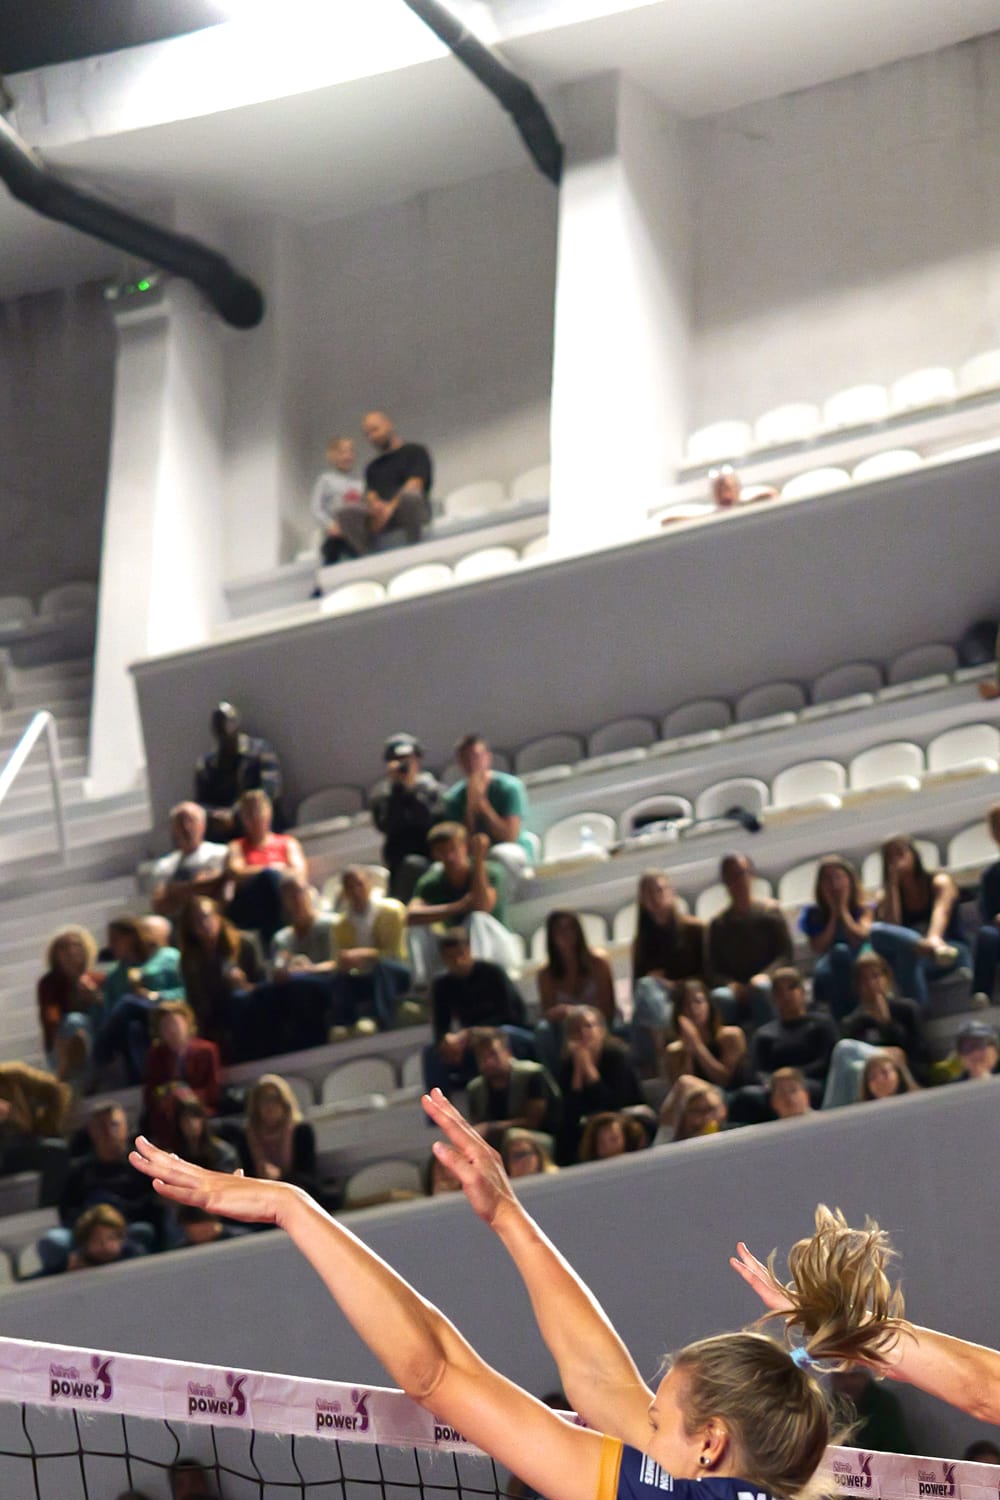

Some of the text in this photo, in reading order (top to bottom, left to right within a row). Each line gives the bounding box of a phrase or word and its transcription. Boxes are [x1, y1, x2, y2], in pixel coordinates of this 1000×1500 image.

[51, 1379, 99, 1398] power
[188, 1396, 234, 1415] power
[316, 1412, 358, 1430] power
[434, 1425, 468, 1443] pow
[919, 1482, 948, 1496] power
